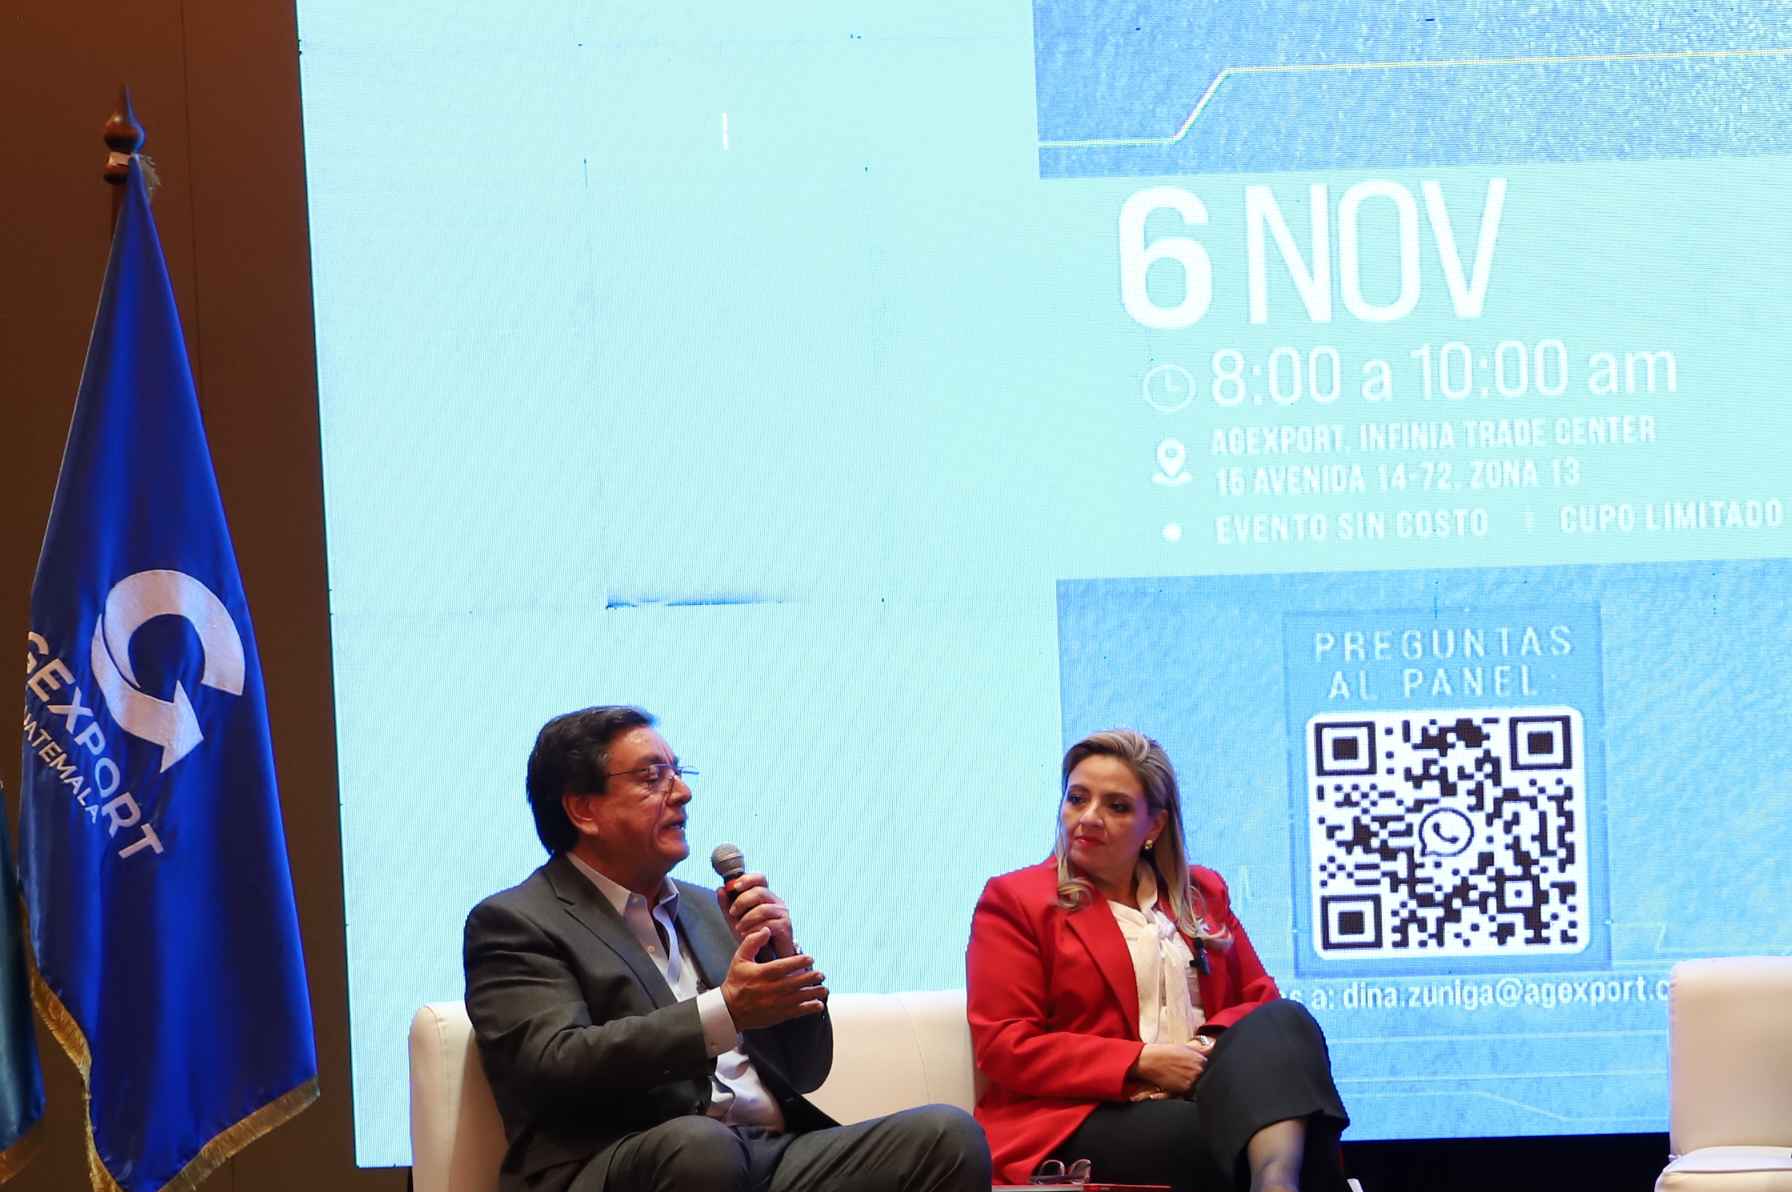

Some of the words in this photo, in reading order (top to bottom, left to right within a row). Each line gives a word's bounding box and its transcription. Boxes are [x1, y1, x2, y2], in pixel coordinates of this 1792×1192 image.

[1119, 186, 1213, 330] 6
[1245, 177, 1507, 325] NOV
[1211, 345, 1341, 407] 8:00
[1361, 358, 1393, 402] a
[1410, 338, 1570, 401] 10:00
[1587, 348, 1678, 396] am
[1360, 420, 1455, 451] INFINIA
[1464, 417, 1546, 448] TRADE
[1555, 414, 1657, 444] CENTER
[1217, 467, 1245, 497] 16
[1254, 463, 1366, 495] AVENIDA
[1470, 459, 1538, 489] ZONA
[1551, 456, 1582, 487] 13
[1215, 513, 1329, 544] EVENTO
[1340, 511, 1385, 540] SIN
[1397, 508, 1489, 538] COSTO
[1560, 502, 1634, 533] CUPO
[1645, 497, 1784, 531] LIMITADO
[1315, 624, 1573, 662] PREGUNTAS
[1328, 669, 1377, 701] AL
[1403, 664, 1537, 698] PANEL
[1311, 988, 1335, 1010] a:
